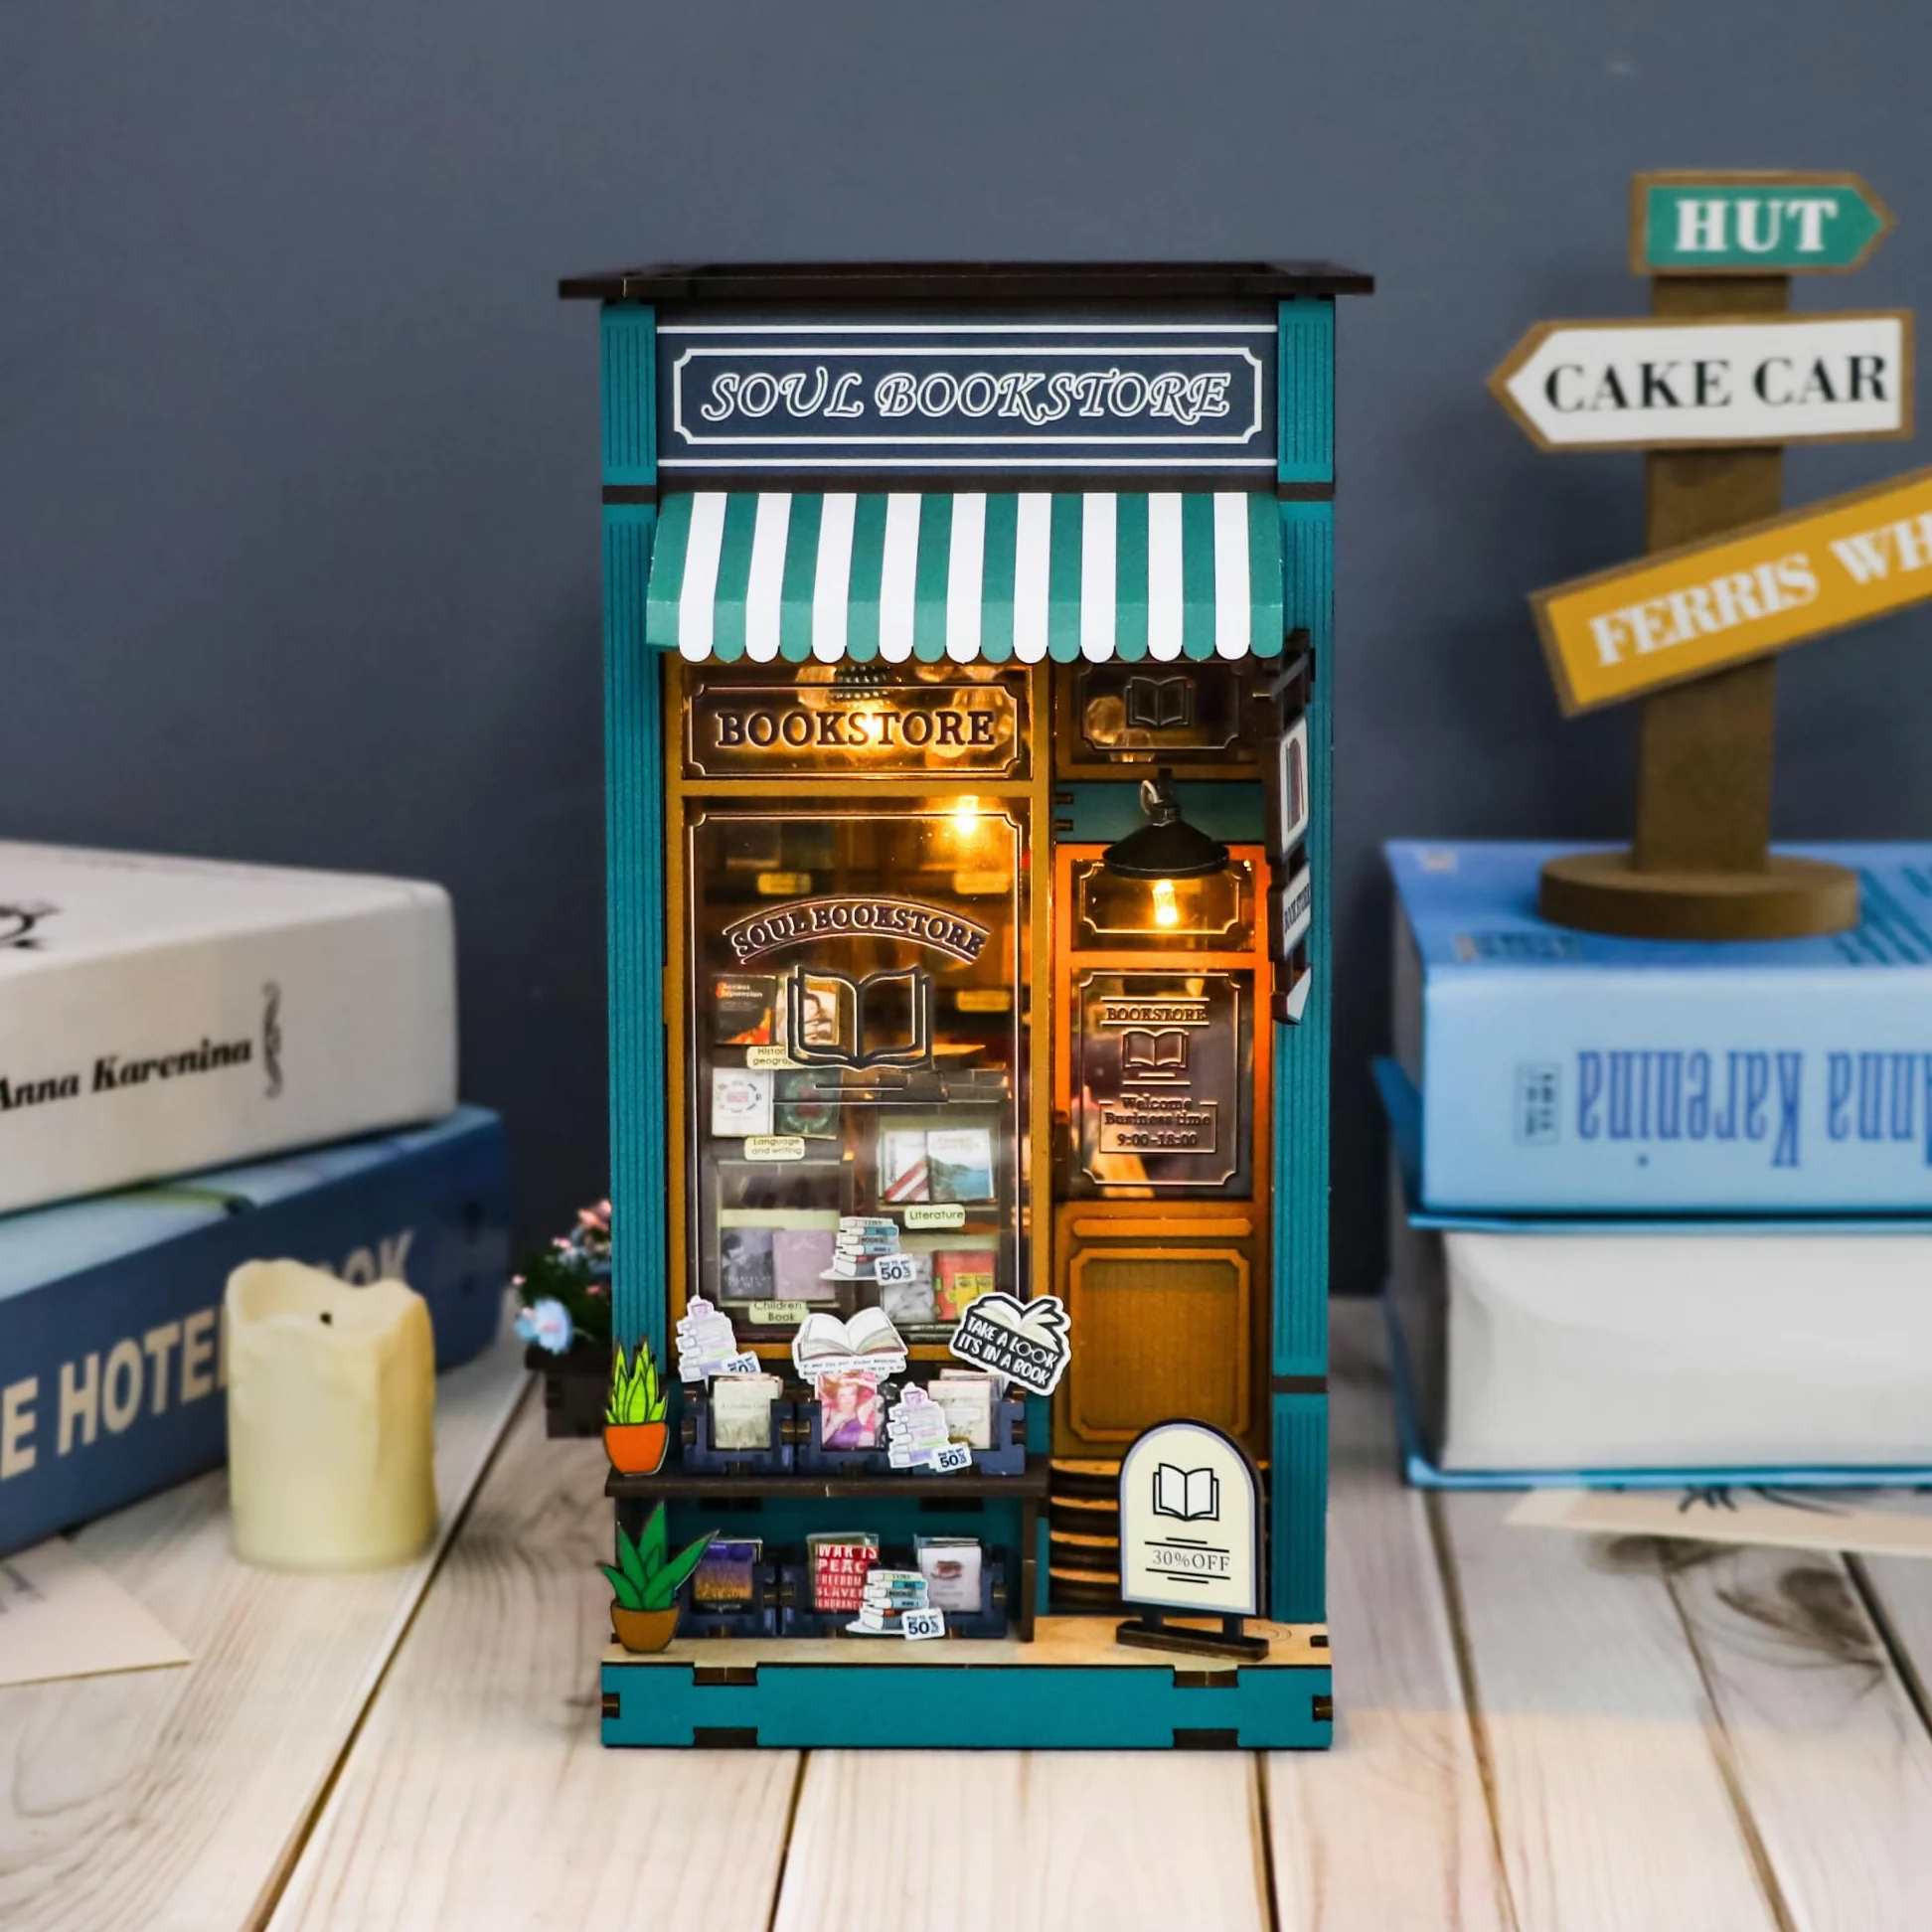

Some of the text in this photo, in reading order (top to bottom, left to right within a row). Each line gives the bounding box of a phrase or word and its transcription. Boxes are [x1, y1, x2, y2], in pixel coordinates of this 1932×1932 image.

[1675, 199, 1839, 252] HUT
[1544, 355, 1892, 413] CAKE CAR
[701, 366, 1231, 425] SOUL BOOKSTORE
[1588, 552, 1820, 667] FERRIS
[715, 710, 995, 747] BOOKSTORE
[730, 904, 989, 960] SOUL BOOKSTORE
[1105, 1005, 1207, 1022] BOOKSTORE
[92, 1037, 252, 1093] Karenina
[1121, 1093, 1192, 1110] Welcome
[1576, 1049, 1804, 1168] Karenina
[1104, 1110, 1212, 1126] Business time
[751, 1146, 802, 1156] and writing
[753, 1138, 800, 1147] Language
[909, 1210, 964, 1220] Literature
[753, 1301, 802, 1311] Children
[768, 1312, 796, 1322] Book
[968, 1316, 1058, 1368] TAKE A LOOK
[982, 1344, 1001, 1362] IN
[1000, 1354, 1012, 1368] A
[1013, 1359, 1050, 1385] BOOK
[818, 1544, 854, 1557] WAR
[1153, 1549, 1230, 1571] 30%OFF
[817, 1558, 866, 1573] PEAC
